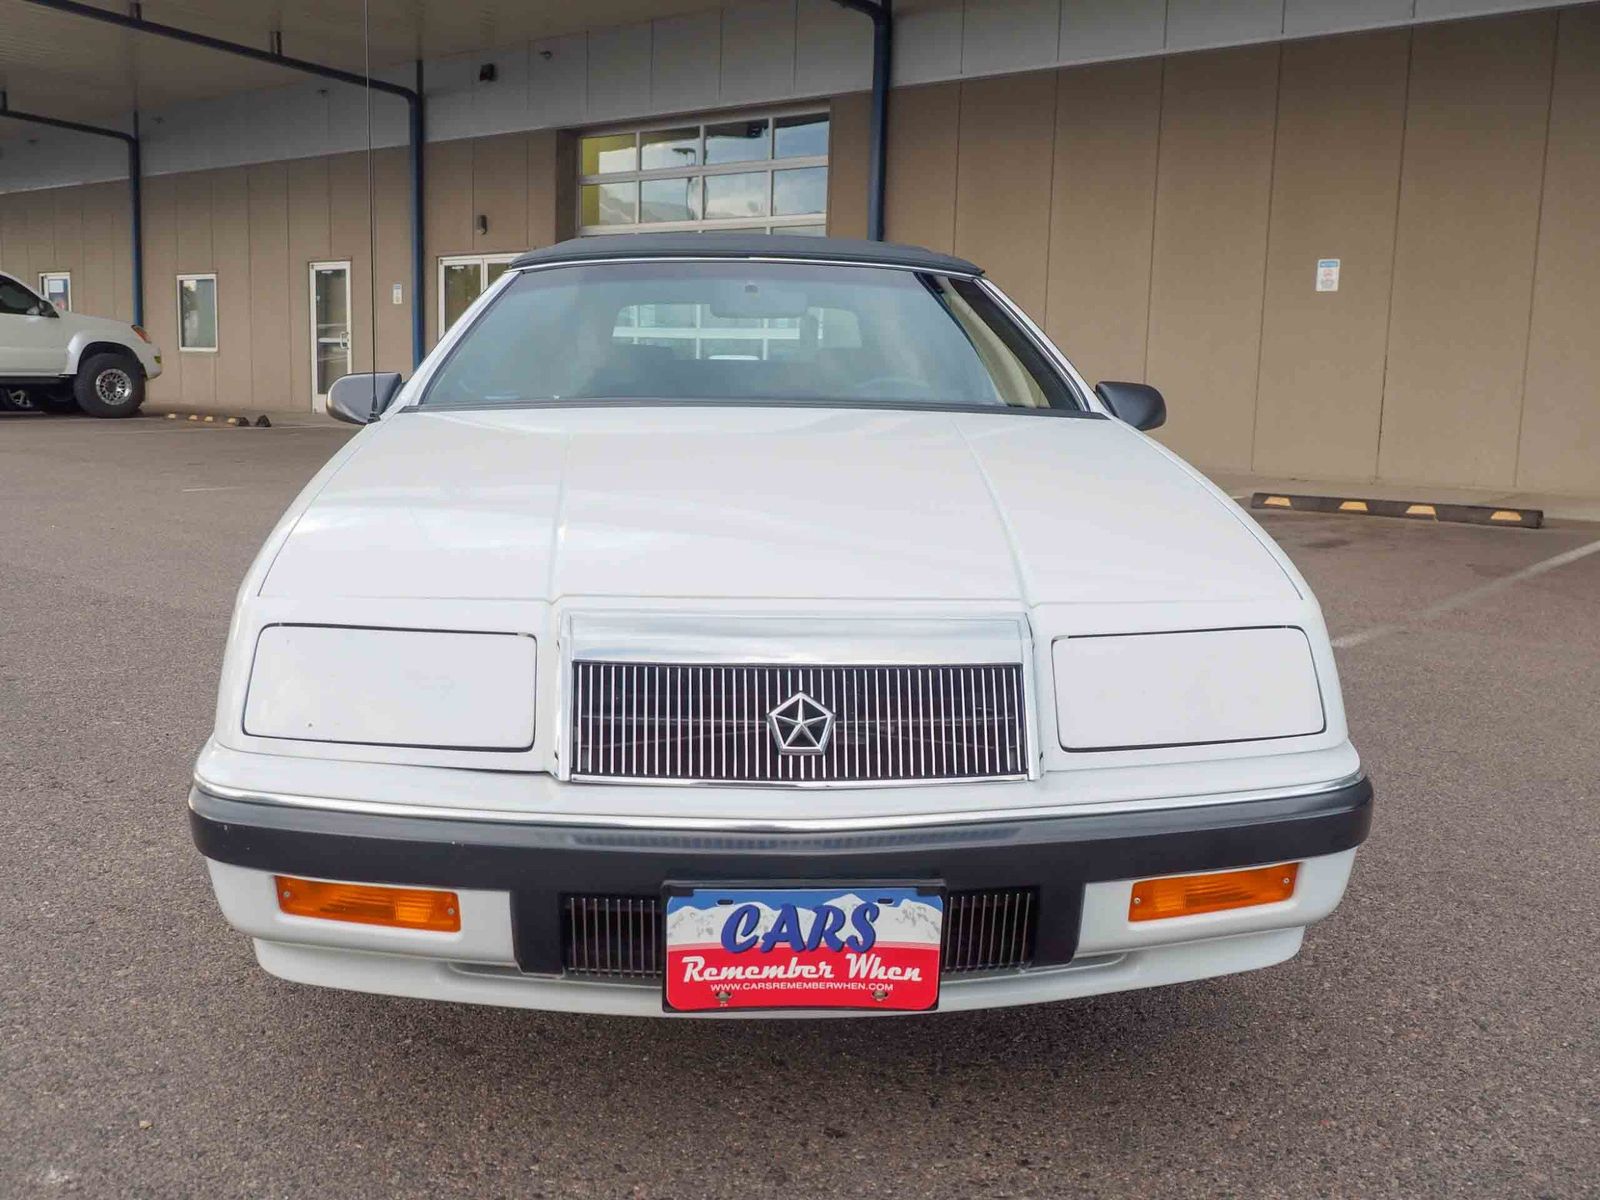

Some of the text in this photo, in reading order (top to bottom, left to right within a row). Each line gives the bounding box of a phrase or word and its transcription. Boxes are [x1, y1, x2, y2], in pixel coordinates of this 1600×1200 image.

[721, 902, 880, 953] CARS
[682, 953, 922, 983] Remember When
[711, 982, 893, 991] WWW.CARSREMEMBERWHEN.COM
